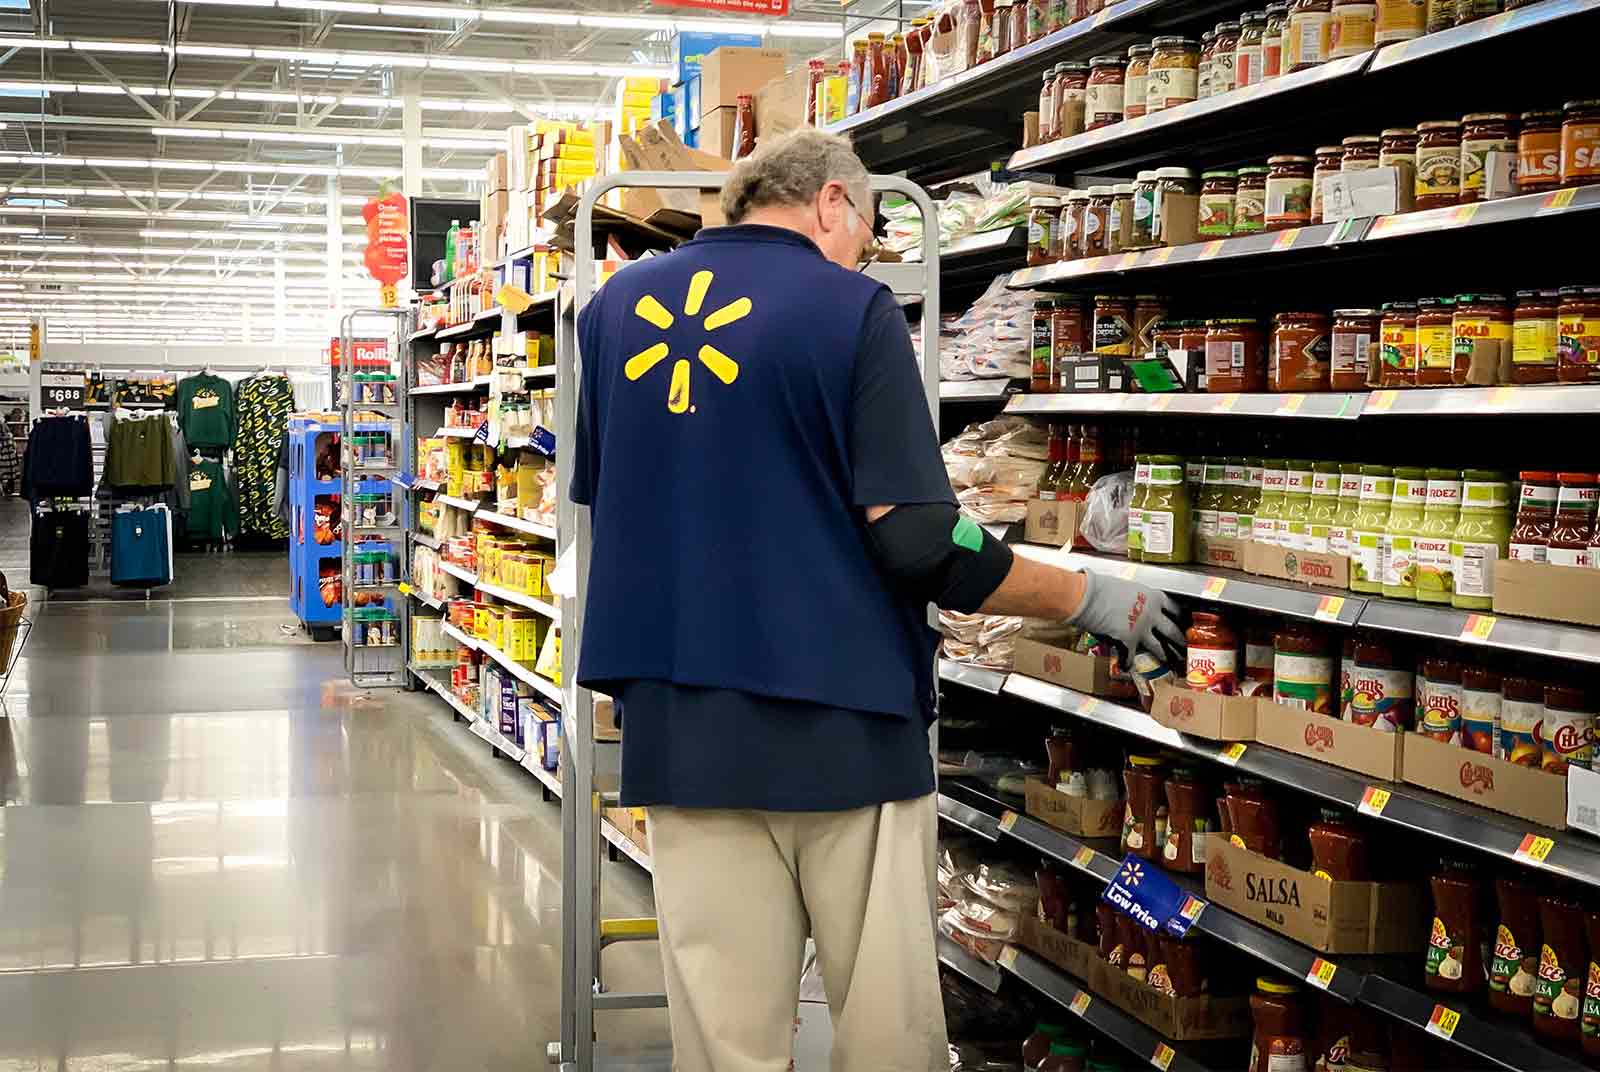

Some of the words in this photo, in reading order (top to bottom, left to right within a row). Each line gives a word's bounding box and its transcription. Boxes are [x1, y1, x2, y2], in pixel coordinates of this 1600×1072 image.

[383, 290, 396, 304] 13
[1245, 872, 1302, 909] SALSA
[1106, 885, 1132, 911] Low
[1129, 902, 1160, 930] Price
[1265, 907, 1286, 926] MILD
